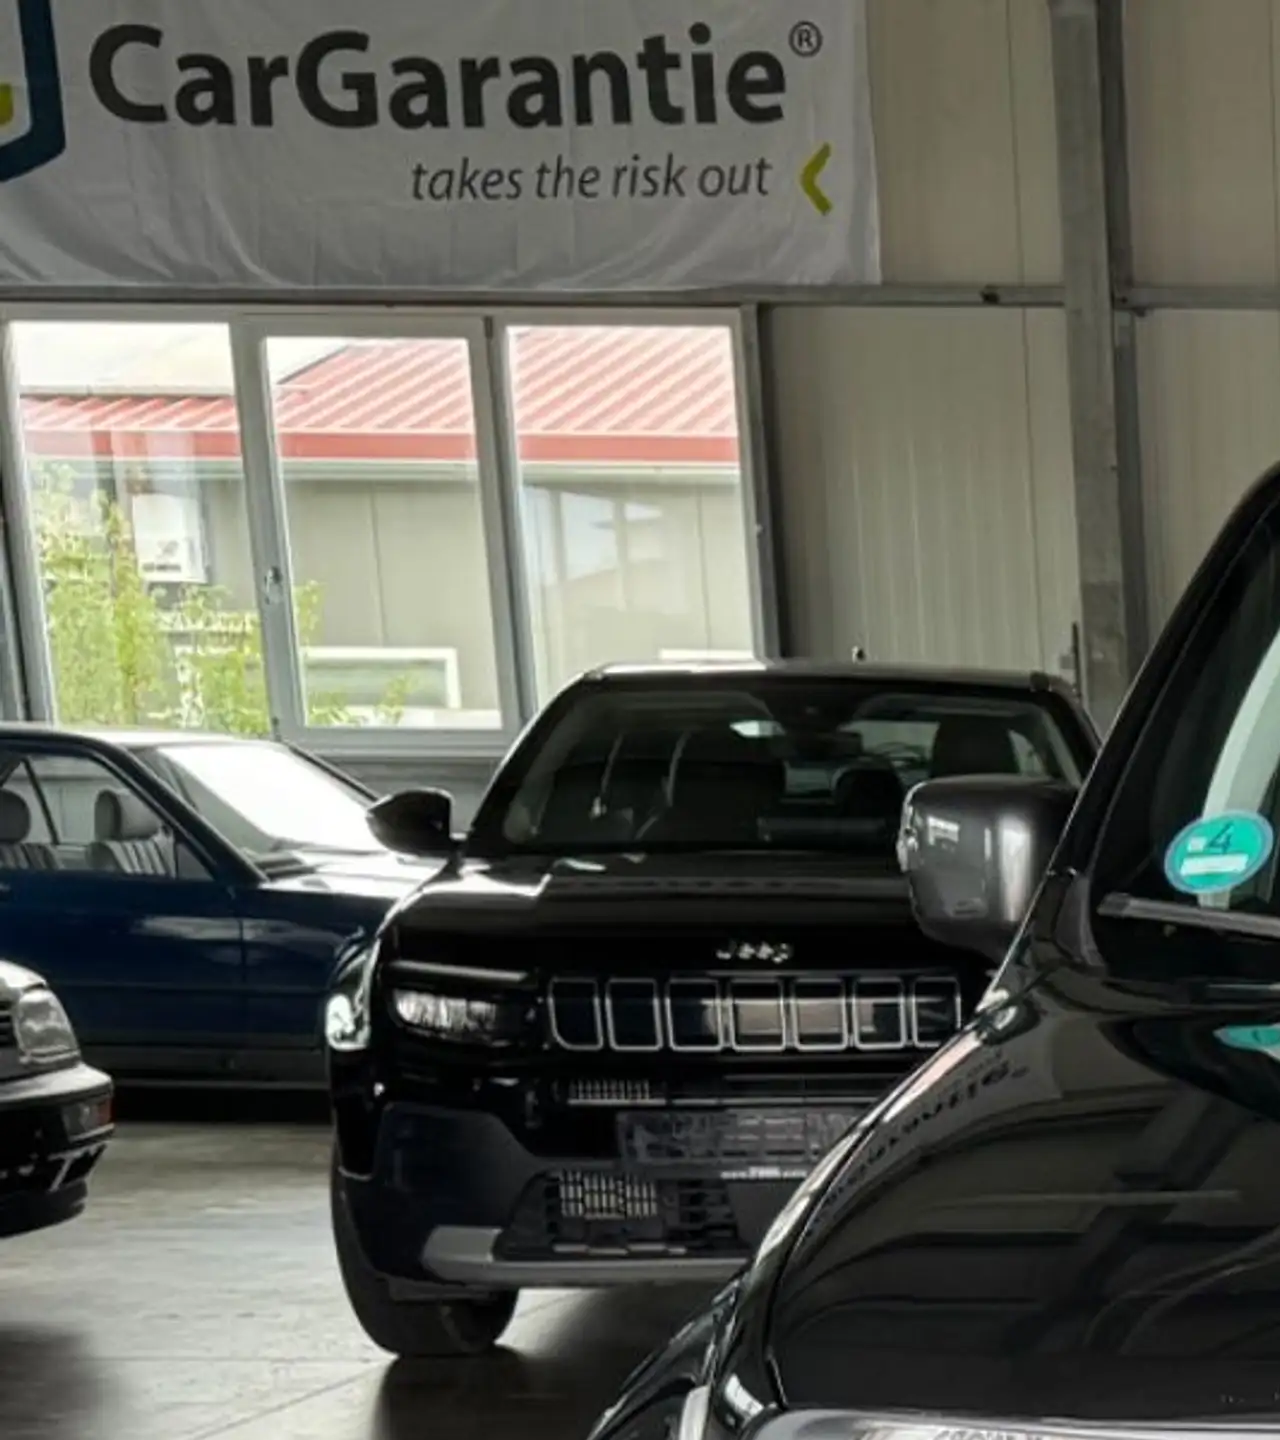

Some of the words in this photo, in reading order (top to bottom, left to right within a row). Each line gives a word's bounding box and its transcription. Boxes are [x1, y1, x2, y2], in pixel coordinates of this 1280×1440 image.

[411, 158, 521, 201] takes
[535, 155, 601, 199] the
[610, 153, 686, 198] risk
[697, 157, 773, 197] out
[1207, 822, 1233, 853] 4
